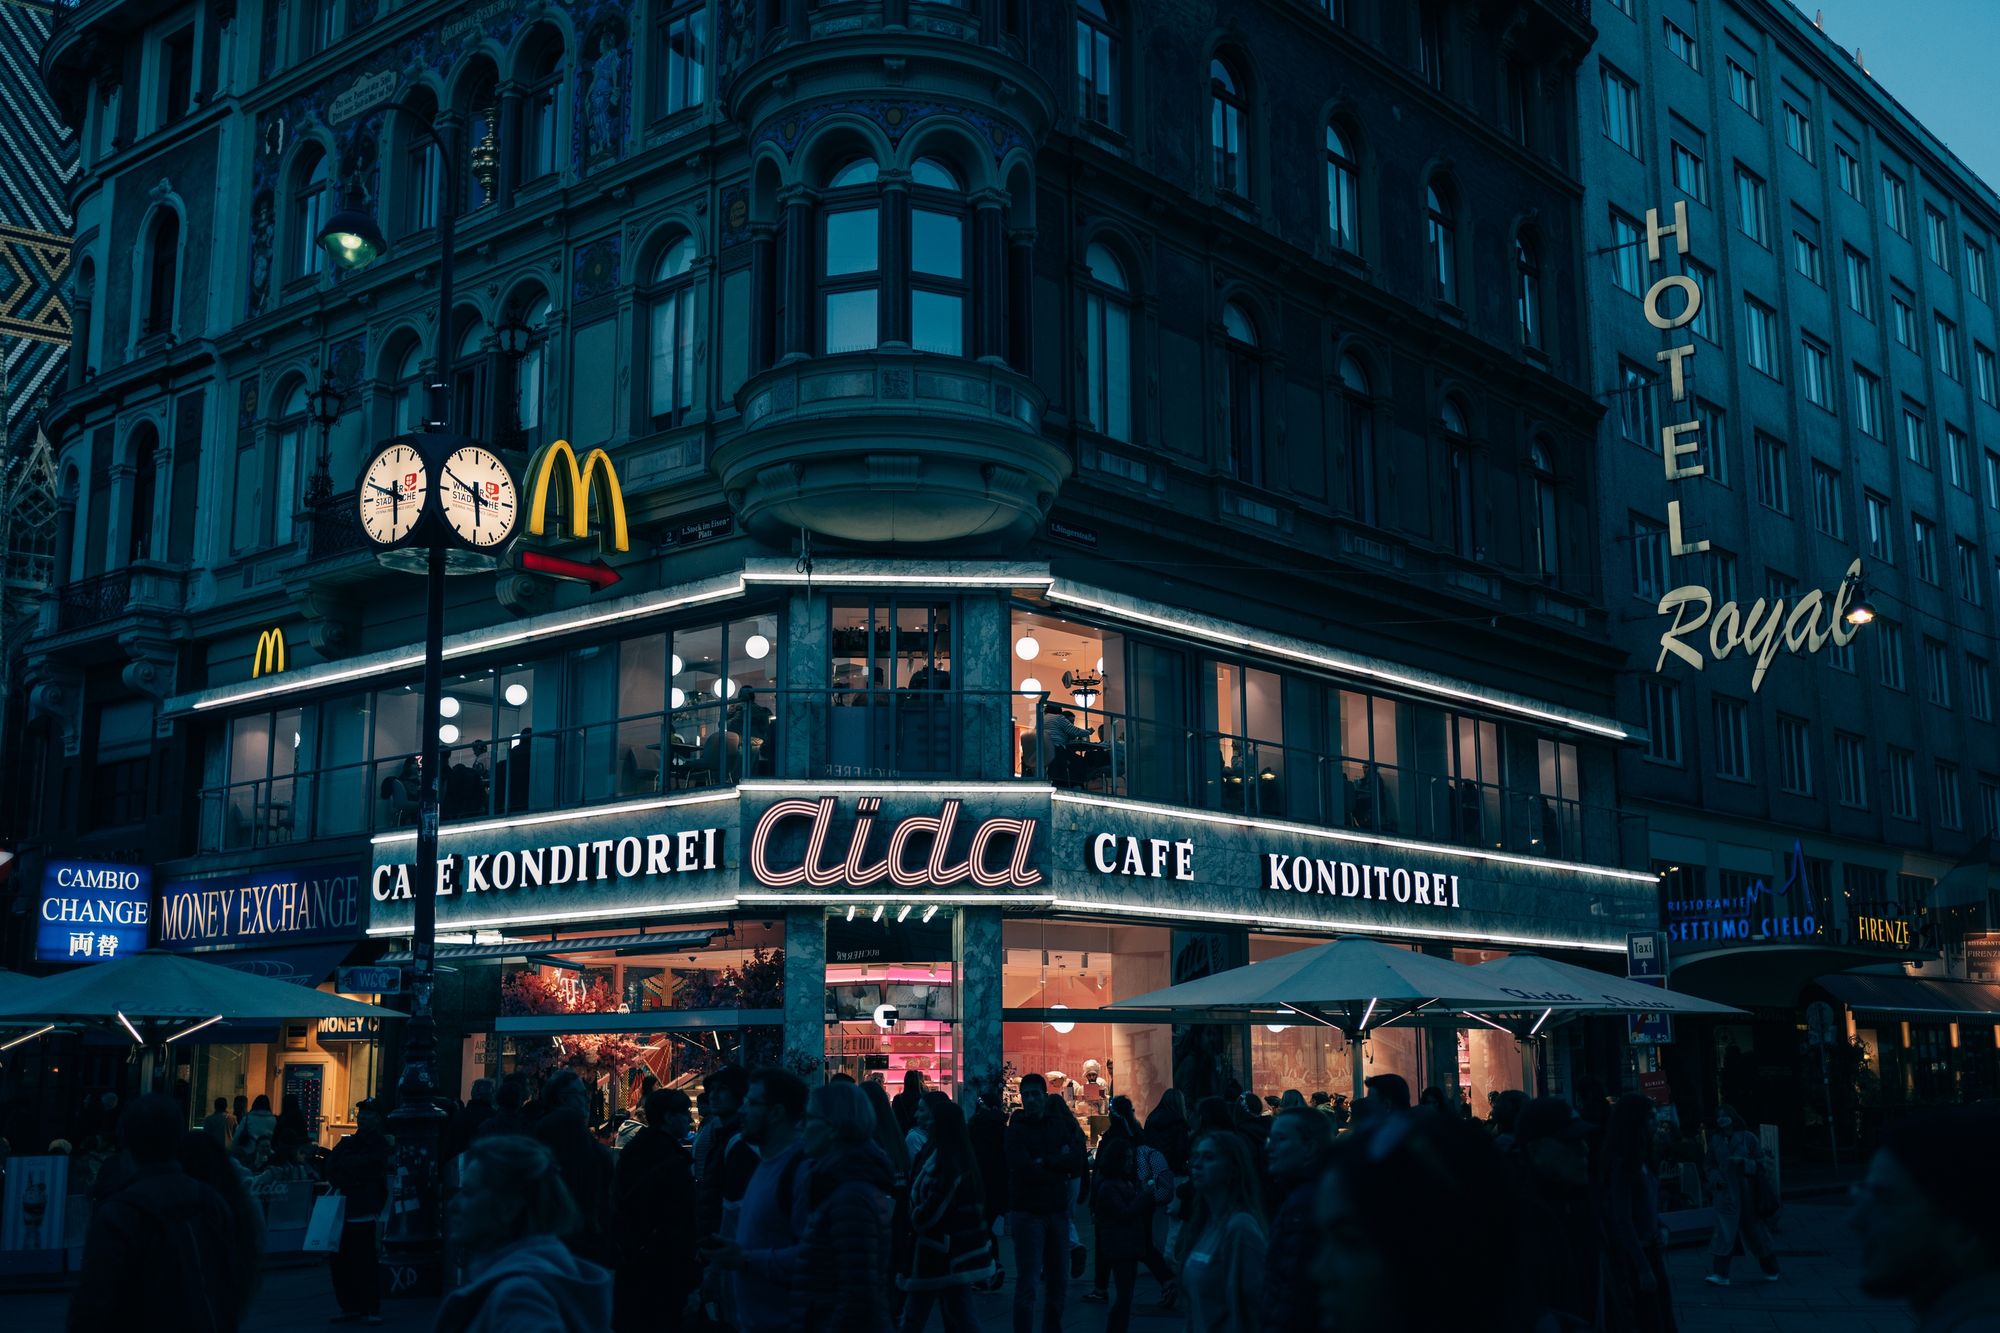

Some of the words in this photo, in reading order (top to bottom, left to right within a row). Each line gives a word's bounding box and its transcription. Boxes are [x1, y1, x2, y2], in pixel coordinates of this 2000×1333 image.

[1644, 200, 1710, 556] HOTEL
[1655, 558, 1861, 694] Royal
[372, 853, 455, 901] CAÉ
[467, 828, 717, 893] KONDITOREI
[1094, 832, 1195, 881] CAFÉ
[1268, 853, 1460, 908] KONDITOREI
[57, 868, 140, 891] CAMBIO
[42, 897, 149, 925] CHANGE
[160, 889, 235, 942] MONEY
[238, 876, 359, 936] EXCHANGE
[1667, 897, 1746, 913] RISTORANTE
[1669, 918, 1750, 941] SETTIMO
[1761, 915, 1815, 938] CIELO
[1858, 916, 1911, 945] FIRENZE
[69, 931, 119, 957] 両替
[1634, 941, 1652, 954] Taxi
[318, 1016, 364, 1033] MONEY
